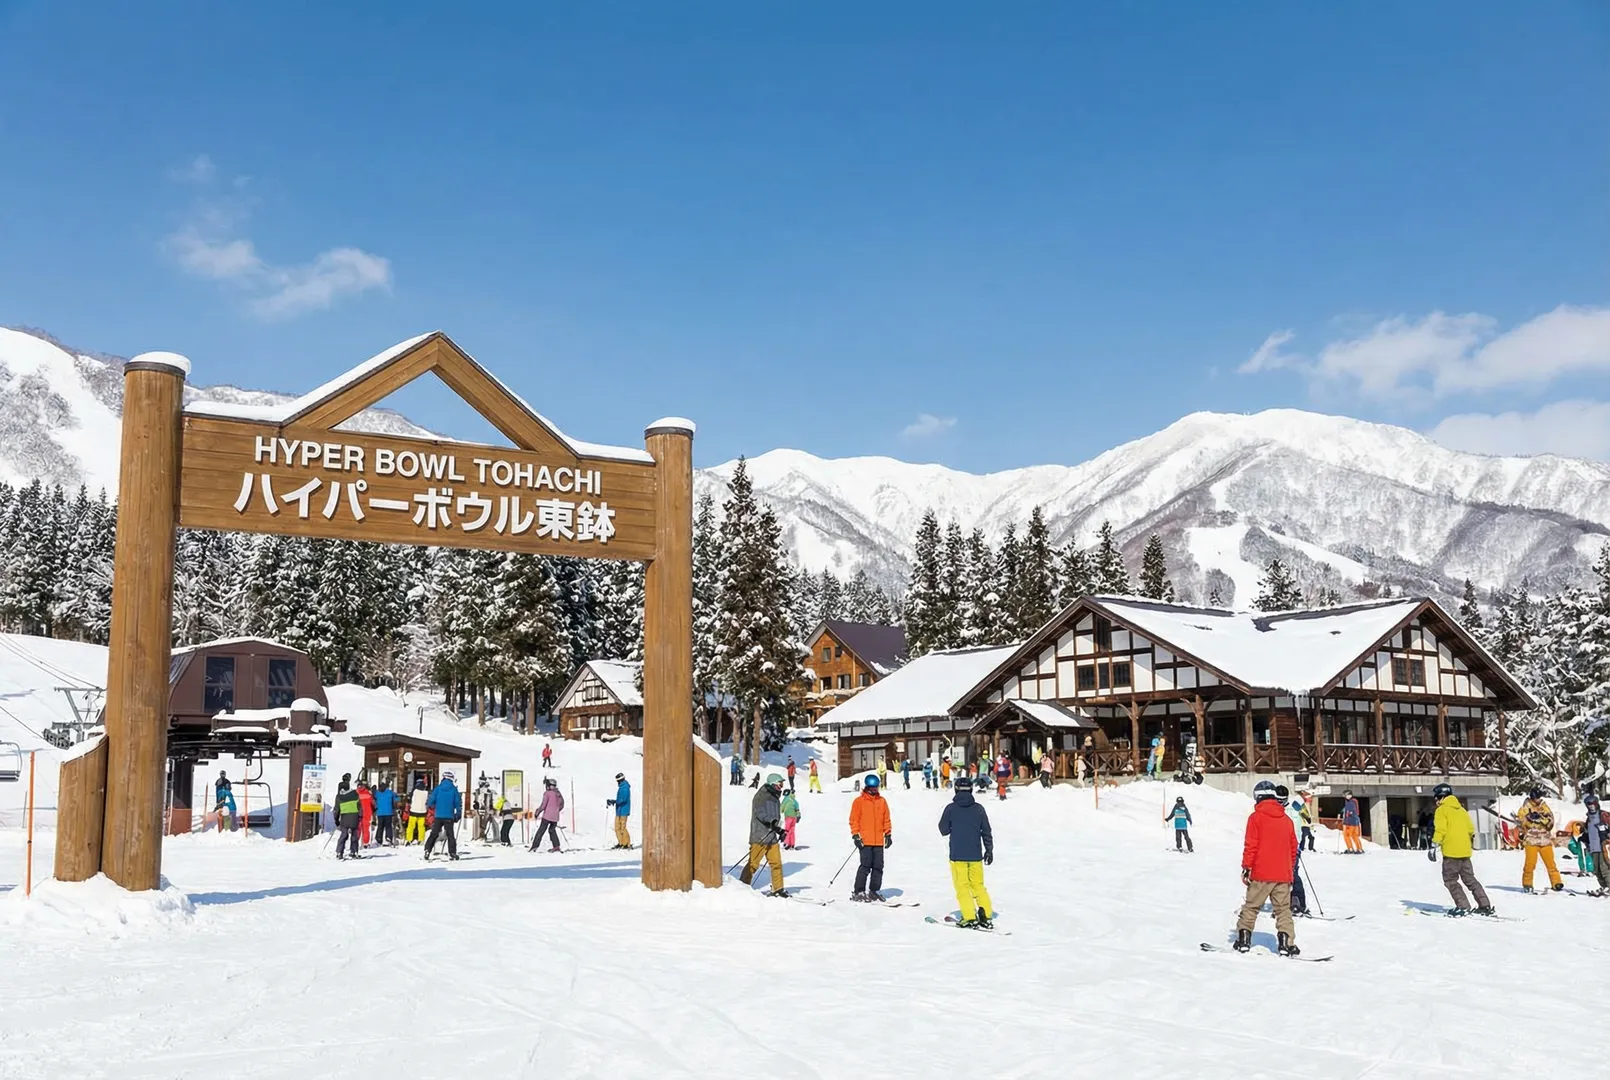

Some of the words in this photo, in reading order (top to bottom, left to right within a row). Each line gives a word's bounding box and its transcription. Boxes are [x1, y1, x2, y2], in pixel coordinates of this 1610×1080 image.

[254, 435, 365, 473] HYPER
[375, 448, 465, 483] BOWL
[473, 458, 602, 497] TOHACHI
[233, 472, 616, 543] ハイパーボウル東鉢
